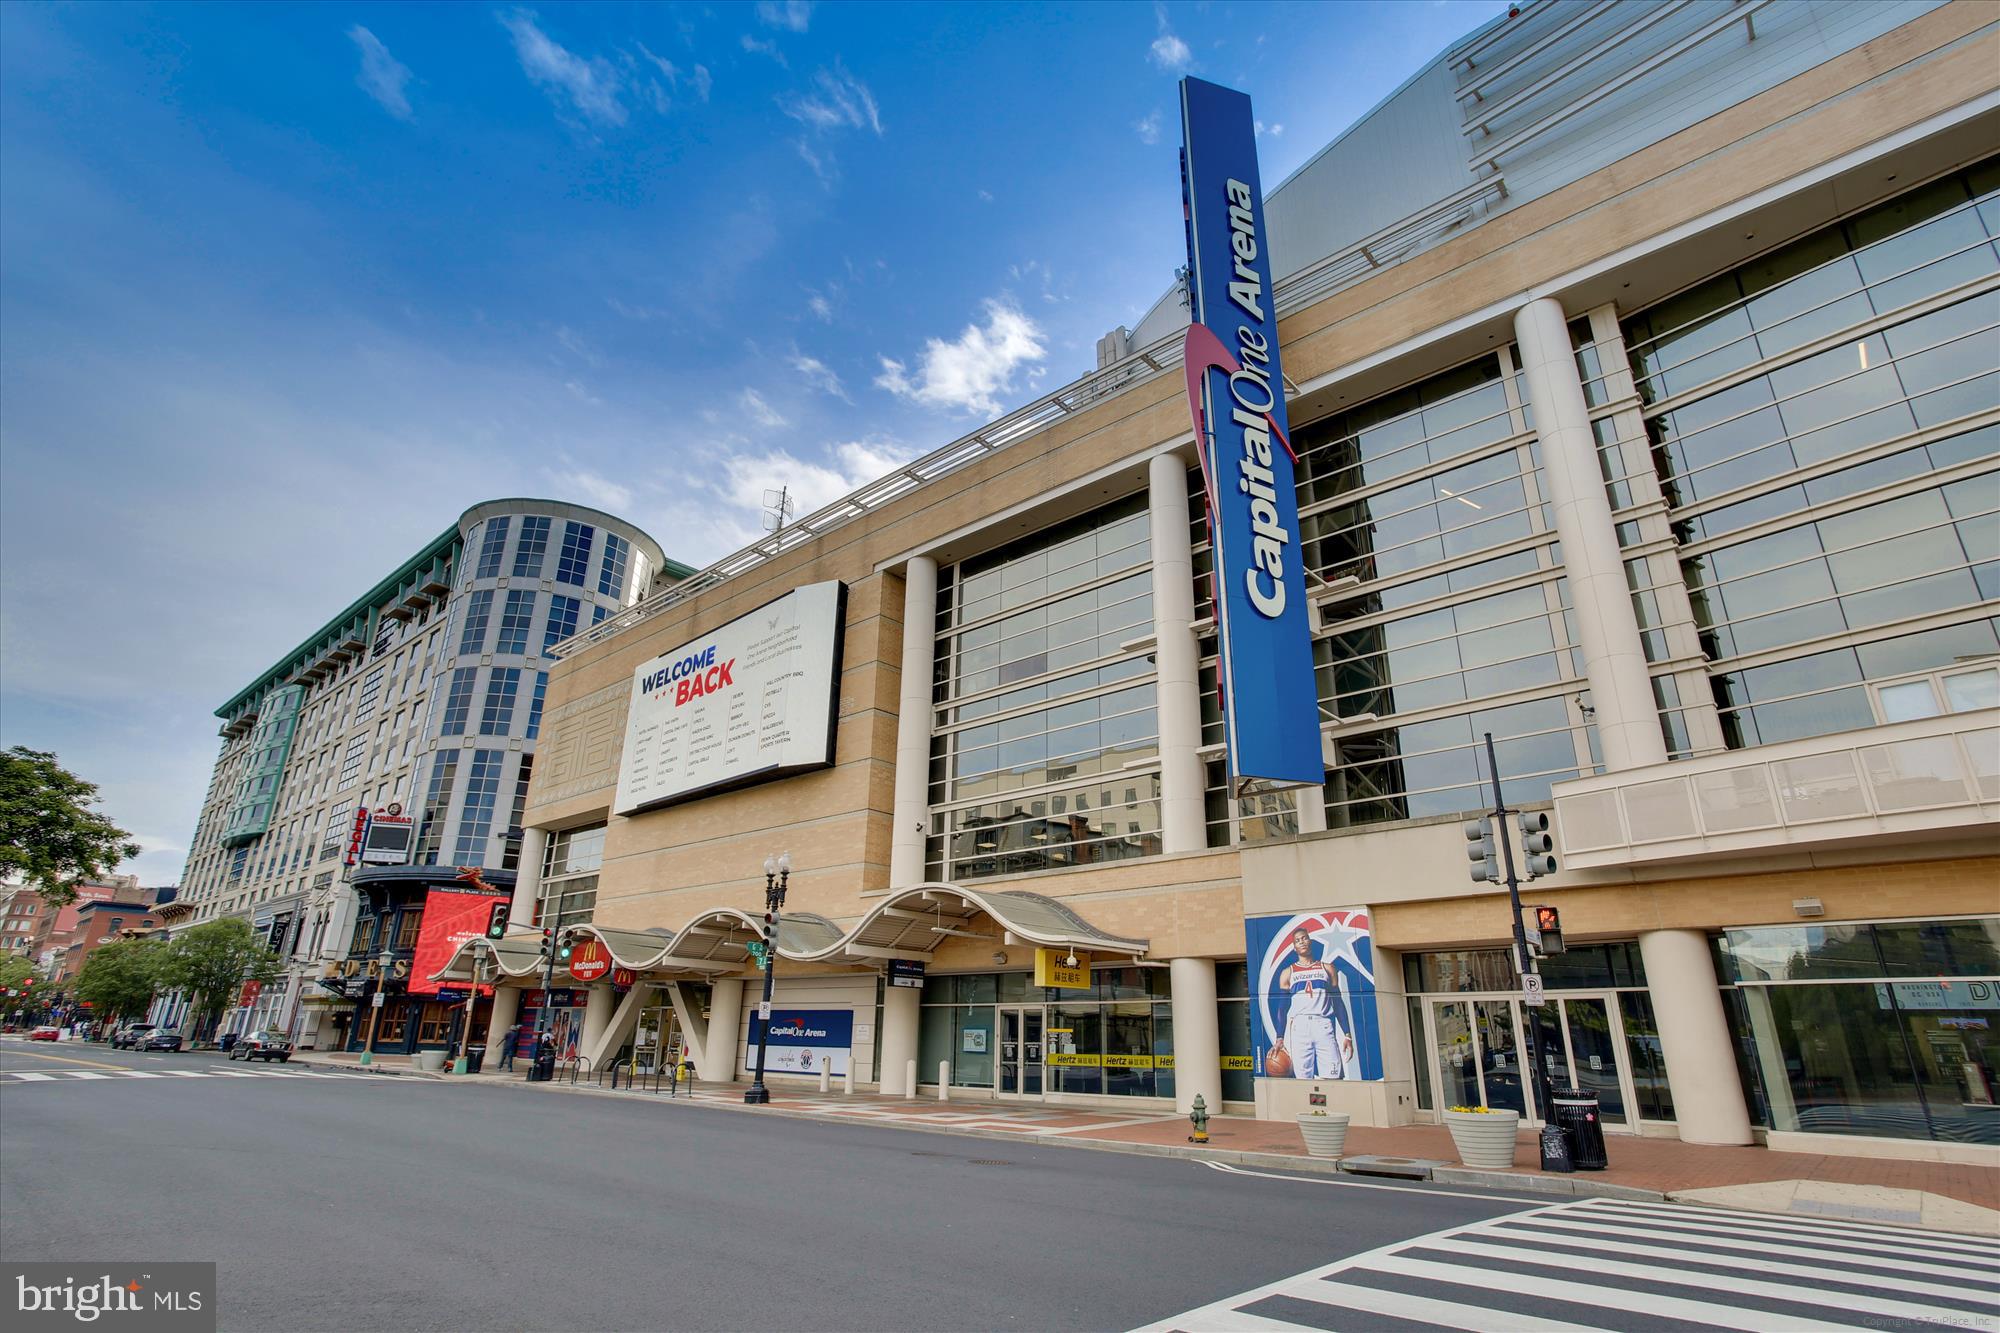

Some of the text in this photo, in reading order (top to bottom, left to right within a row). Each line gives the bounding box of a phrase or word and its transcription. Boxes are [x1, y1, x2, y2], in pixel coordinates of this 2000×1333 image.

[1227, 178, 1264, 321] Arena
[642, 645, 716, 695] WELCOME
[675, 657, 736, 707] BACK
[373, 815, 412, 824] CINEMAS
[347, 807, 368, 865] REGAL
[573, 960, 604, 970] McDonald's
[1054, 955, 1082, 970] Hez
[1304, 980, 1313, 998] 4
[804, 1028, 826, 1037] Arena
[1057, 1055, 1076, 1064] Hertz
[1106, 1056, 1127, 1065] Hertz
[1159, 1057, 1175, 1066] Her
[1228, 1058, 1252, 1068] Hertz
